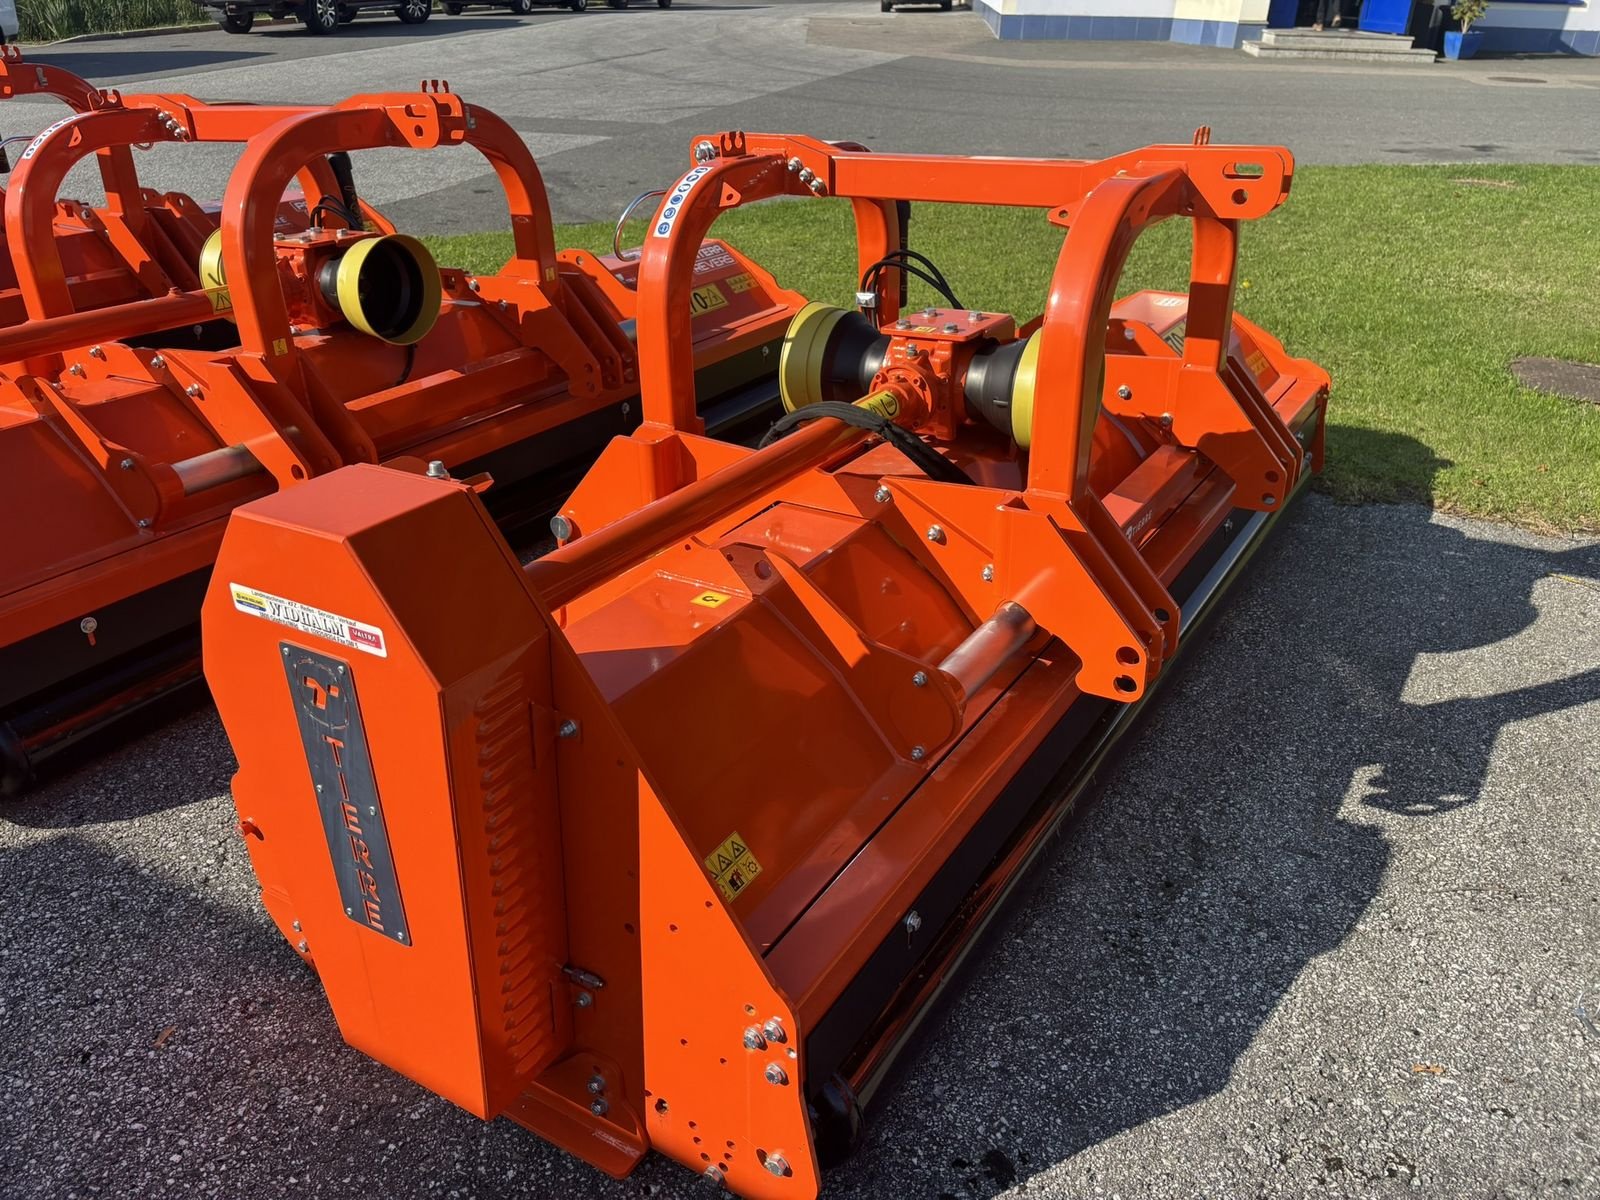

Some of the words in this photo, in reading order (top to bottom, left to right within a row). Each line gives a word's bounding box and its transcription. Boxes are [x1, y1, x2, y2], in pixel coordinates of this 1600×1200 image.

[268, 600, 346, 638] WIDHALM
[352, 629, 377, 643] VALTRA
[321, 734, 385, 932] TIERRE
